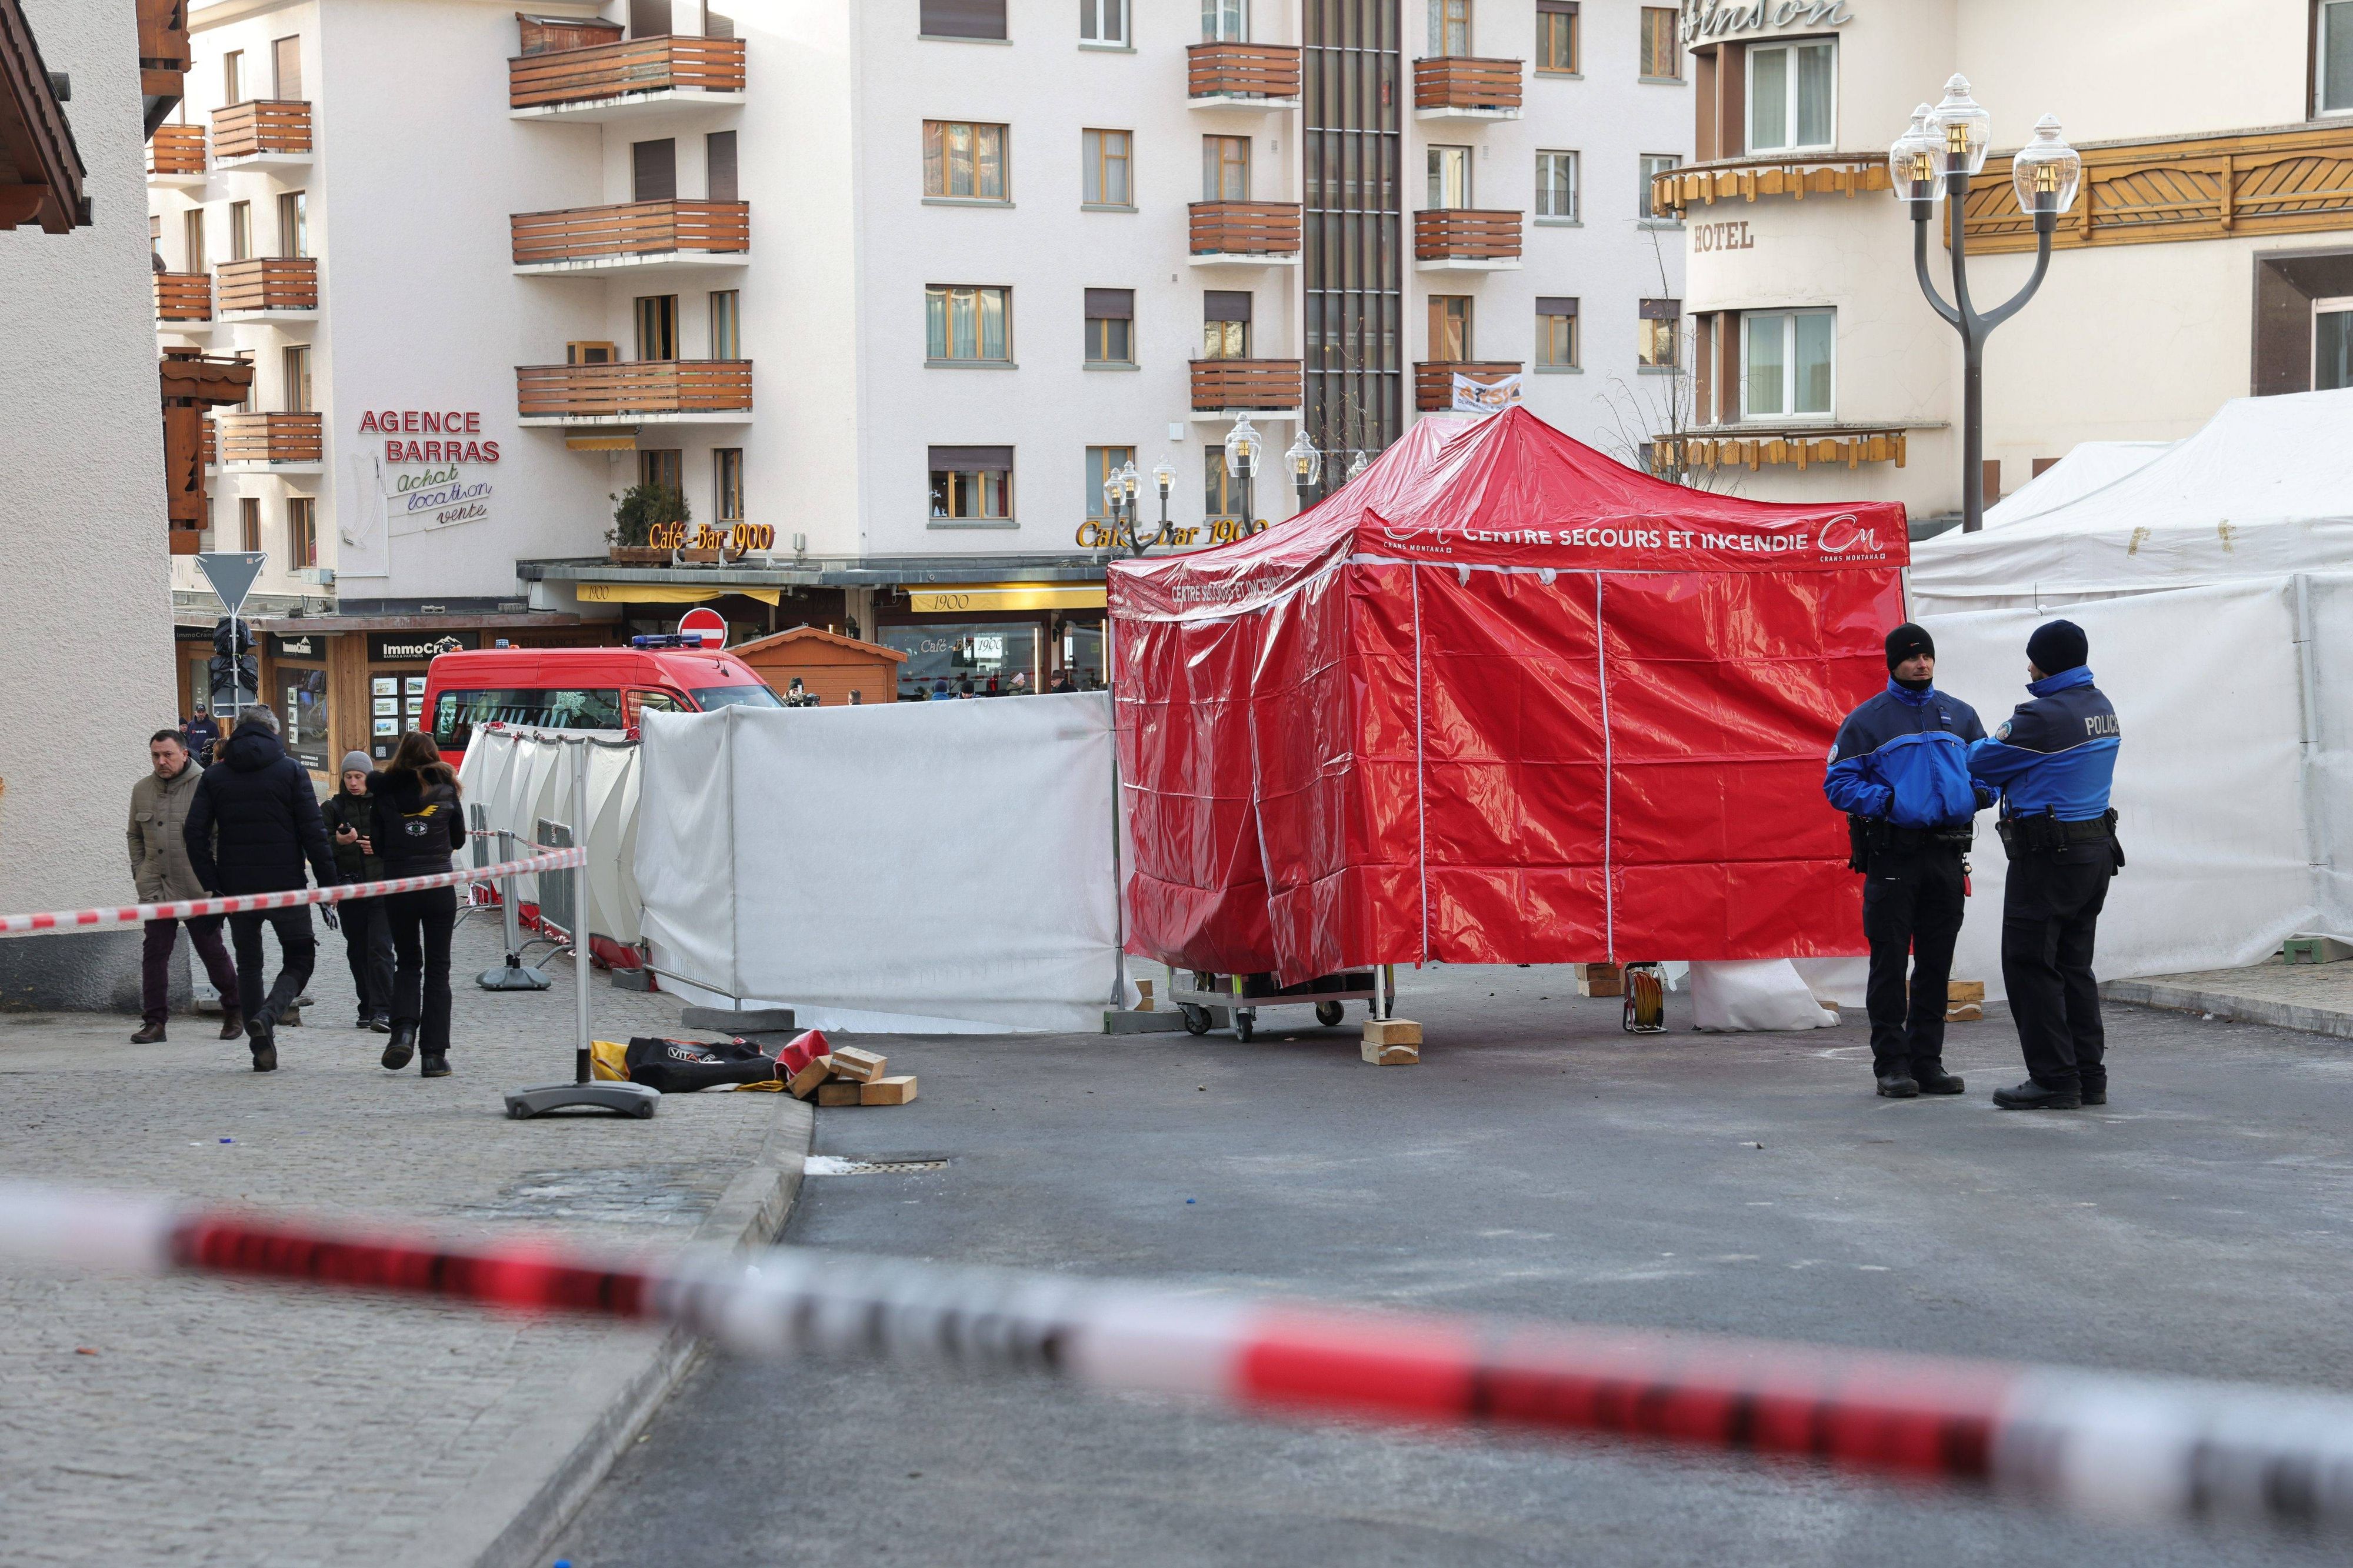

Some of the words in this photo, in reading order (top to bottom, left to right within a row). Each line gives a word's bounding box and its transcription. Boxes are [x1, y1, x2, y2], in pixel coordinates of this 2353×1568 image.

[1695, 221, 1754, 253] HOTEL
[359, 410, 480, 433] AGENCE
[386, 440, 499, 462] BARRAS
[398, 463, 458, 492] achat
[408, 482, 492, 511] location
[436, 503, 486, 523] vente
[729, 523, 773, 557] 1900
[1409, 545, 1444, 553] MONTANA
[1462, 529, 1552, 544] CENTRE
[1559, 528, 1661, 548] SECOURS
[1668, 531, 1695, 548] ET
[1701, 533, 1809, 552] INCENDIE
[589, 585, 609, 600] 1900
[933, 595, 969, 610] 1900
[1172, 585, 1200, 602] CENTRE
[383, 642, 463, 655] ImmoCras
[920, 638, 947, 653] Café
[978, 639, 1004, 652] 1900
[2084, 714, 2119, 736] POLICE
